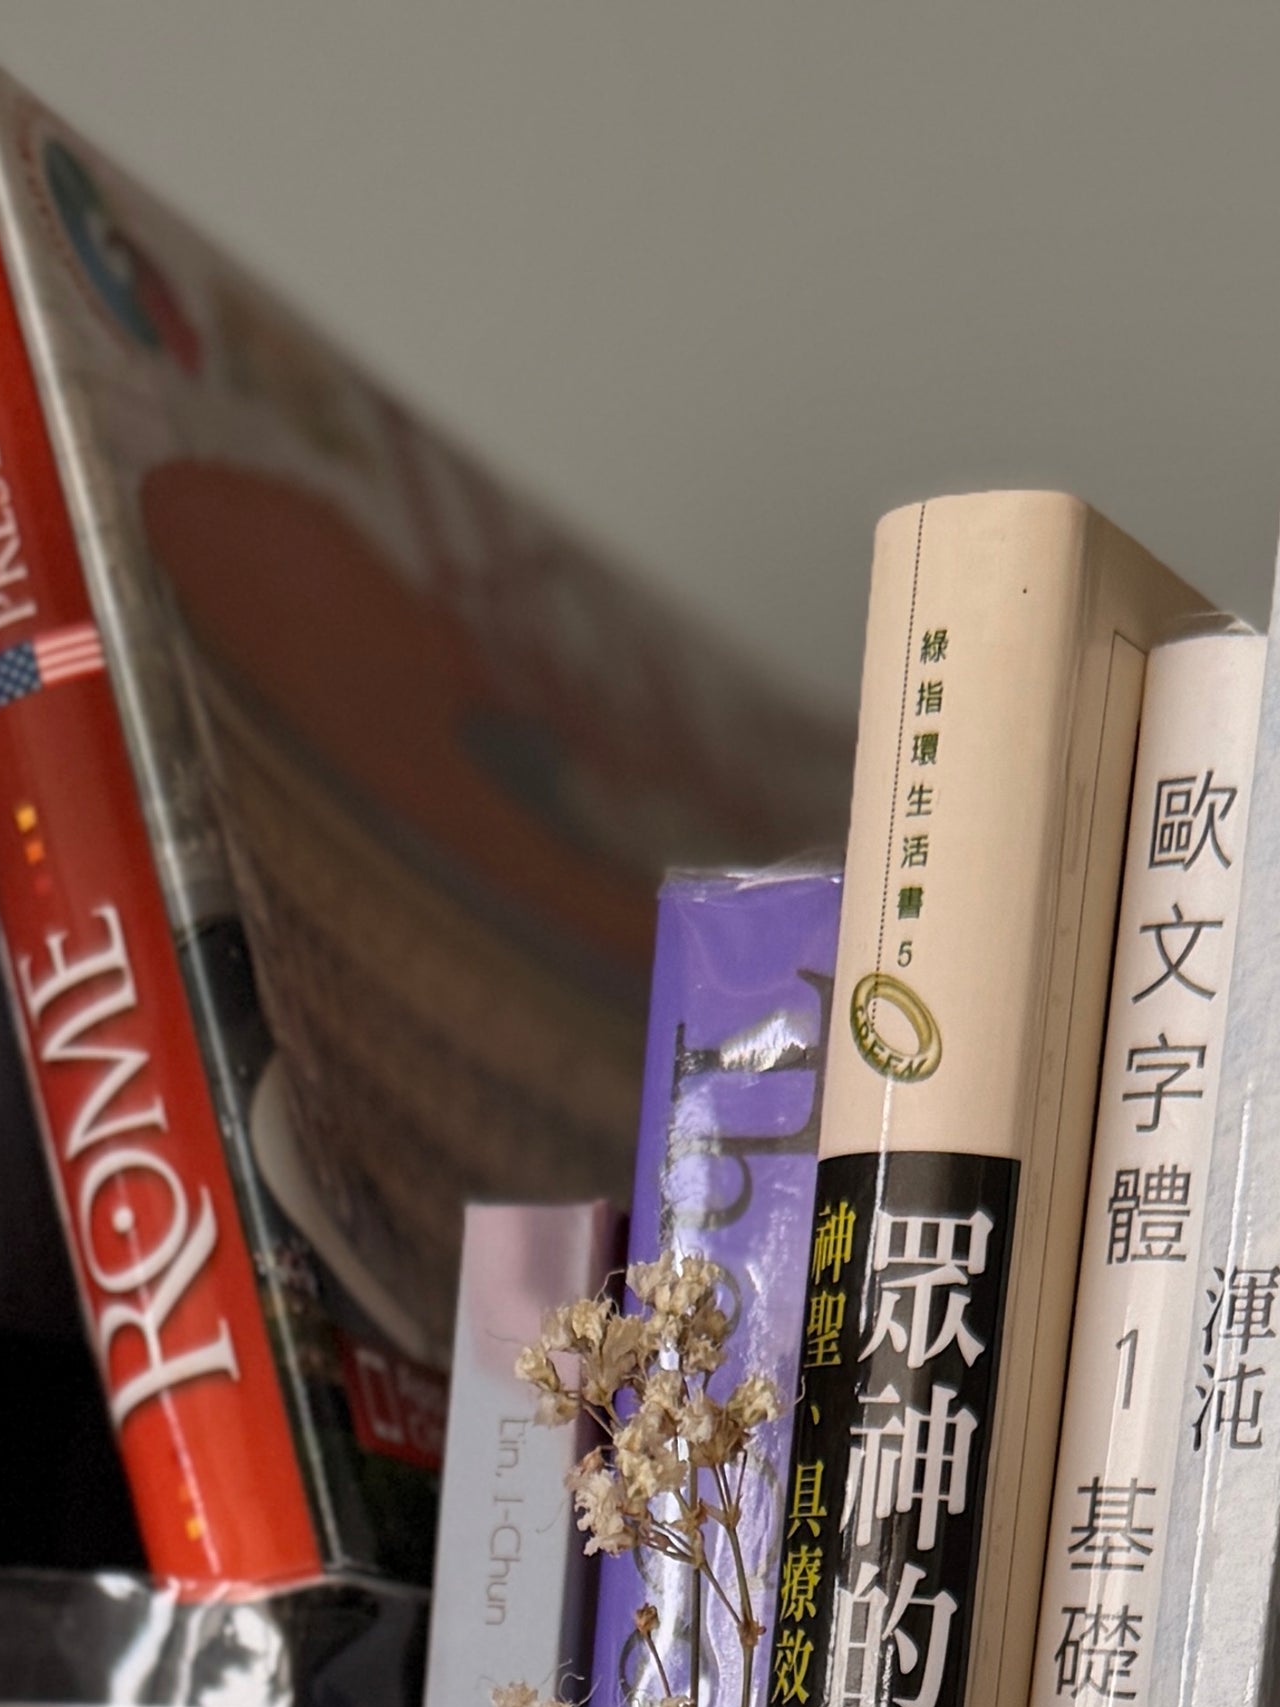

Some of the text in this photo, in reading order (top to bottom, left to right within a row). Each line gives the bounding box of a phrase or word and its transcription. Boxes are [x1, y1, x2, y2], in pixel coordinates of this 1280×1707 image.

[20, 902, 241, 1432] ROME
[1105, 769, 1238, 1266] 歐文字體
